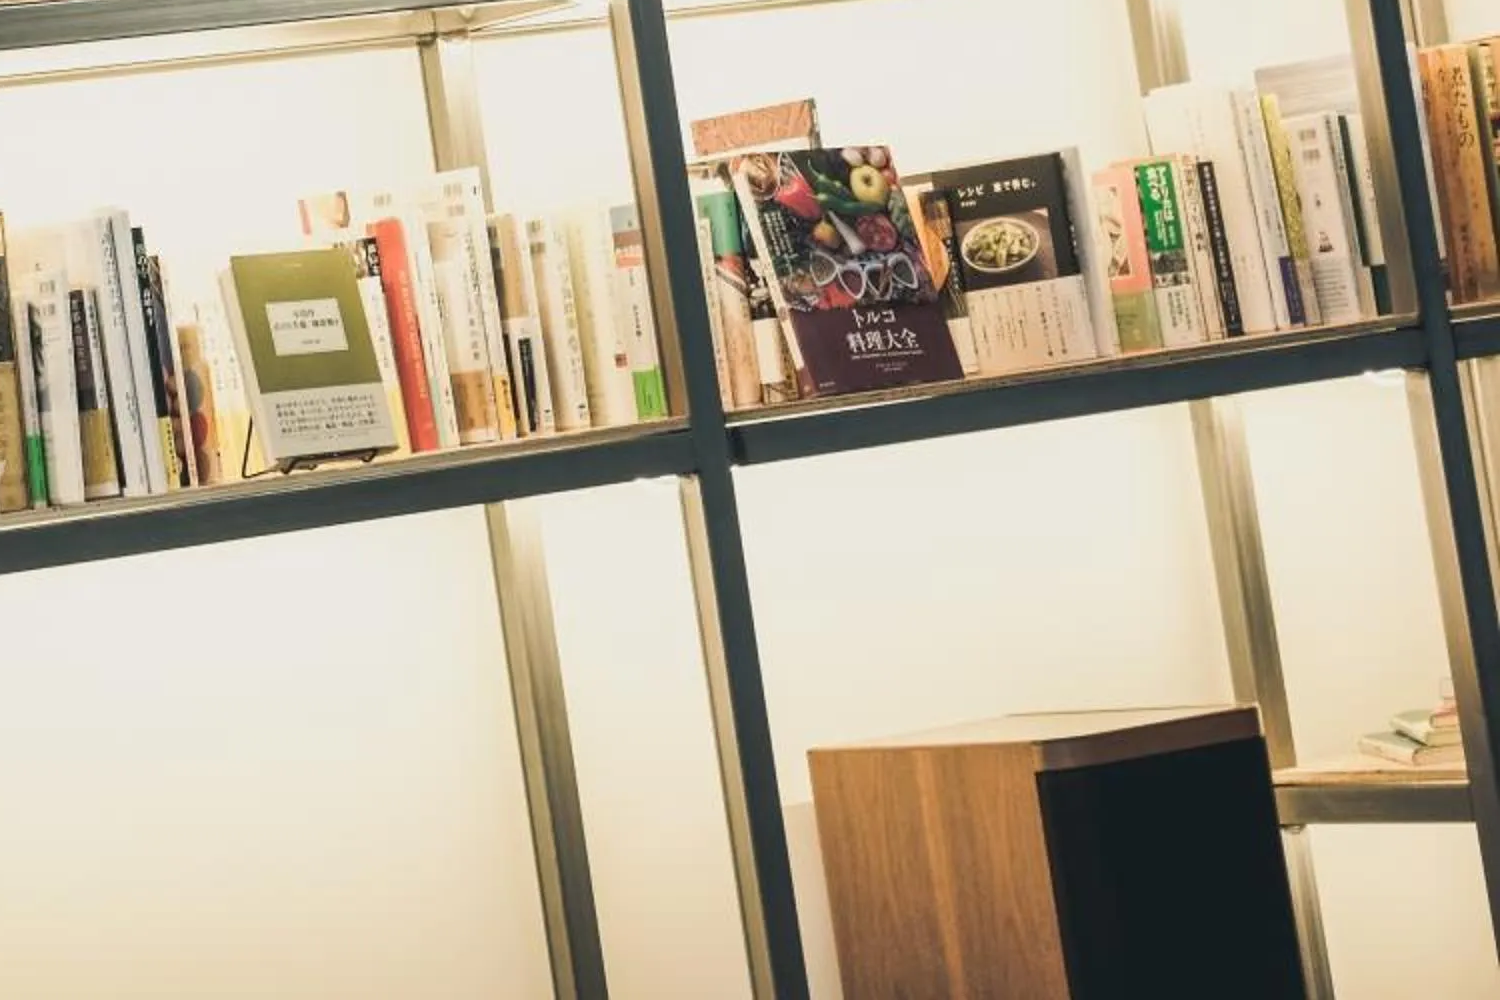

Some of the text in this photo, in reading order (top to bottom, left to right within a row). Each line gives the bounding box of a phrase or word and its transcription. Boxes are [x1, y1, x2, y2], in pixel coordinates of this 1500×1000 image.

[852, 308, 897, 328] トルコ
[845, 327, 920, 353] 料理大全
